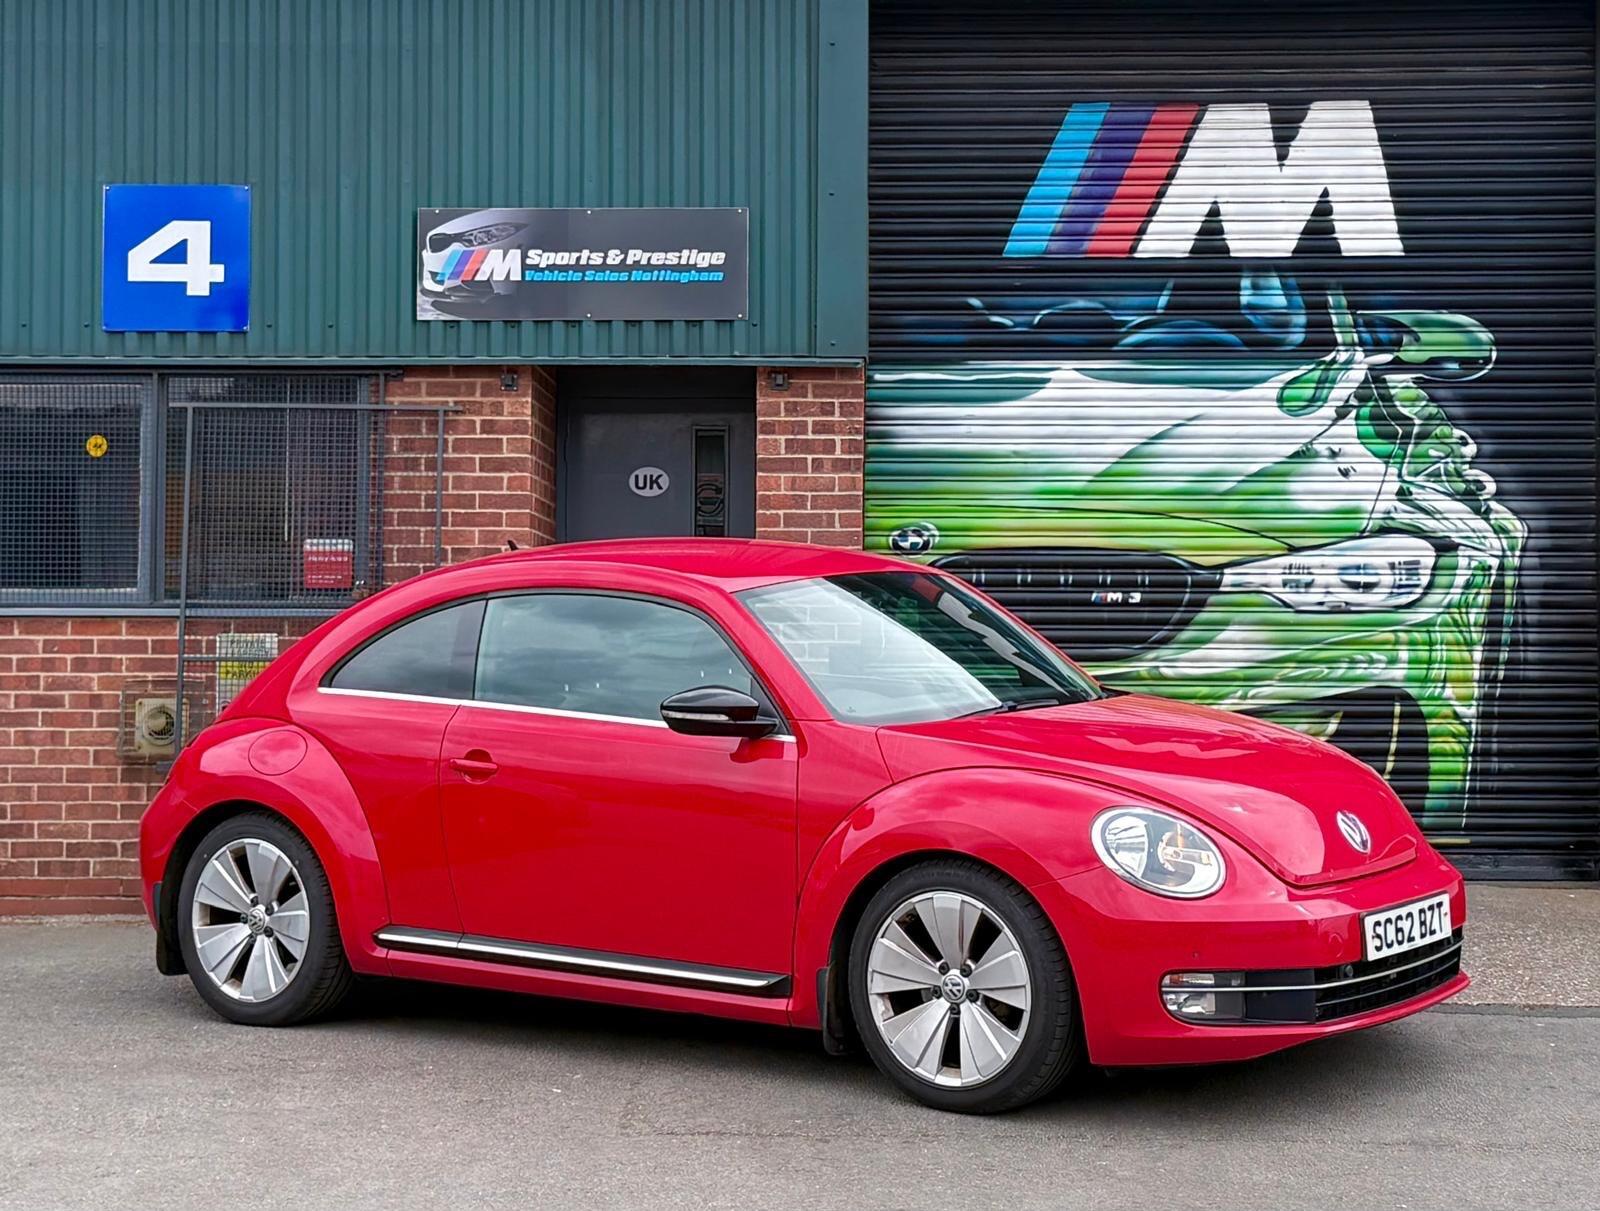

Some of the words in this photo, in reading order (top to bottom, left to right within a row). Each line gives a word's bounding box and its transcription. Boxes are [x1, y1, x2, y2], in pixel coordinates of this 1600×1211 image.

[1133, 99, 1405, 258] M
[127, 219, 225, 296] 4
[474, 249, 522, 281] M
[525, 248, 605, 268] Sports
[606, 248, 625, 265] &
[626, 248, 726, 268] Prestige
[525, 270, 583, 281] Vehicle
[584, 270, 629, 281] Sales
[631, 269, 724, 283] Nottingham
[634, 473, 664, 491] UK
[1371, 911, 1416, 952] SC62
[1418, 901, 1445, 940] BZT
